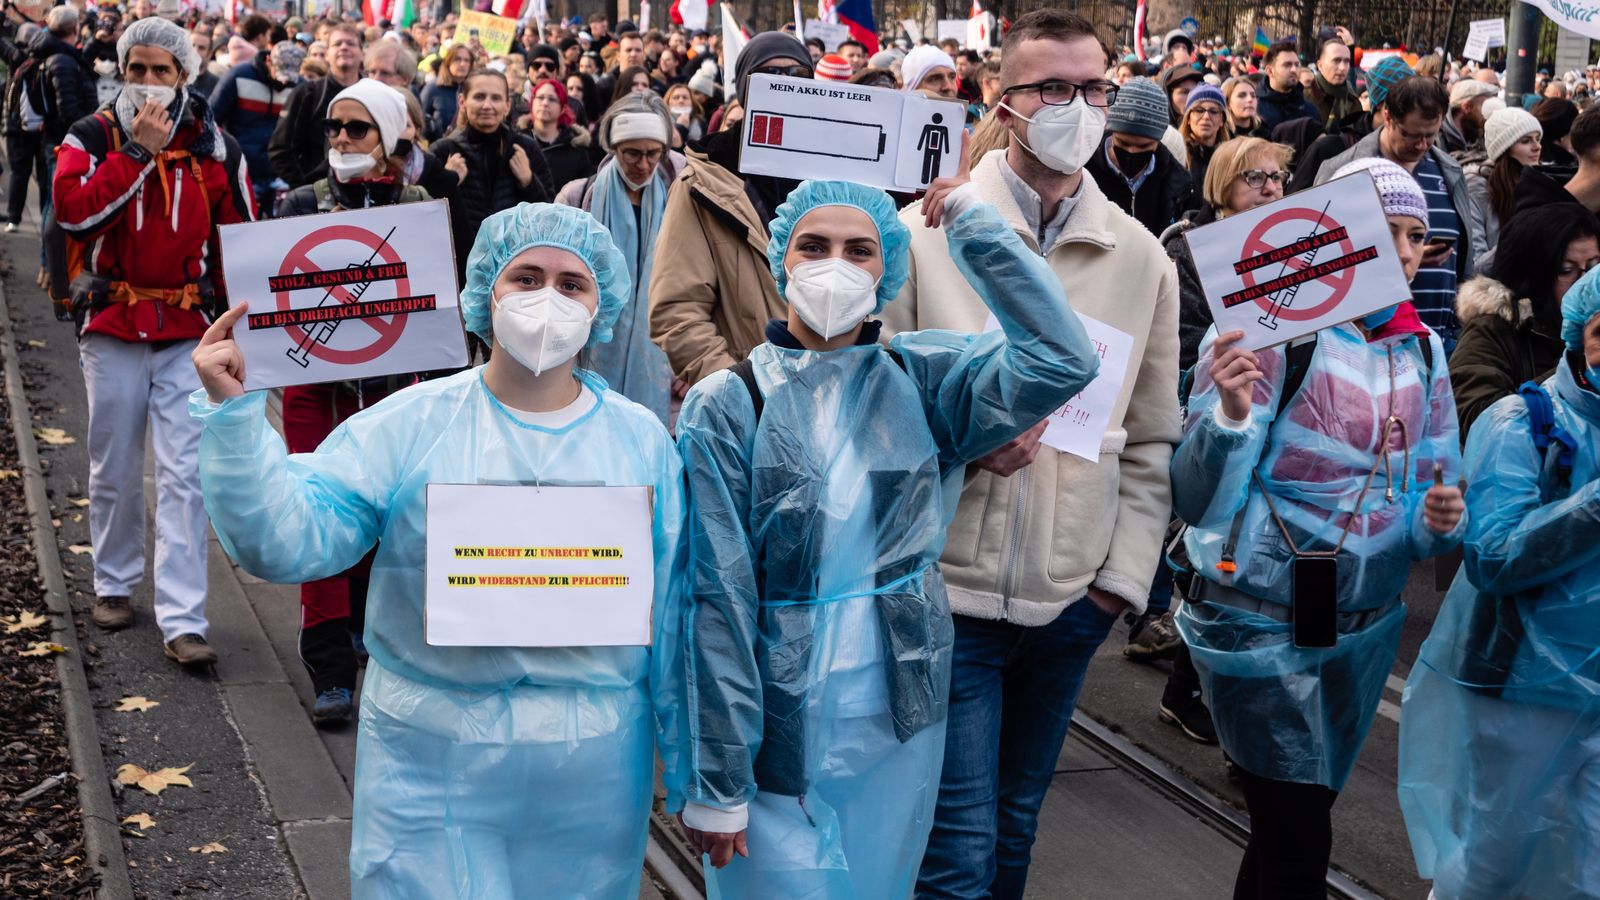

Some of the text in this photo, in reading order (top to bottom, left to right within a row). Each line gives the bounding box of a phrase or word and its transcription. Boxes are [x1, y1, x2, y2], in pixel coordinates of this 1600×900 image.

[769, 83, 872, 102] MEIN AKKU IST LEER
[1235, 228, 1347, 273] STOLZ, GESUND & FREI
[269, 263, 407, 290] STOLZ, GESUND & FREI
[1223, 248, 1377, 306] ICH BIN DREIFACH UNGEIMPFT
[250, 296, 436, 327] ICH BIN DREIFACH UNGEIMPFT
[455, 548, 623, 559] WENN RECHT ZU UNRECHT WIRD,
[448, 576, 630, 586] WIRD WIDERSTAND ZUR PFLICHT!!!!
